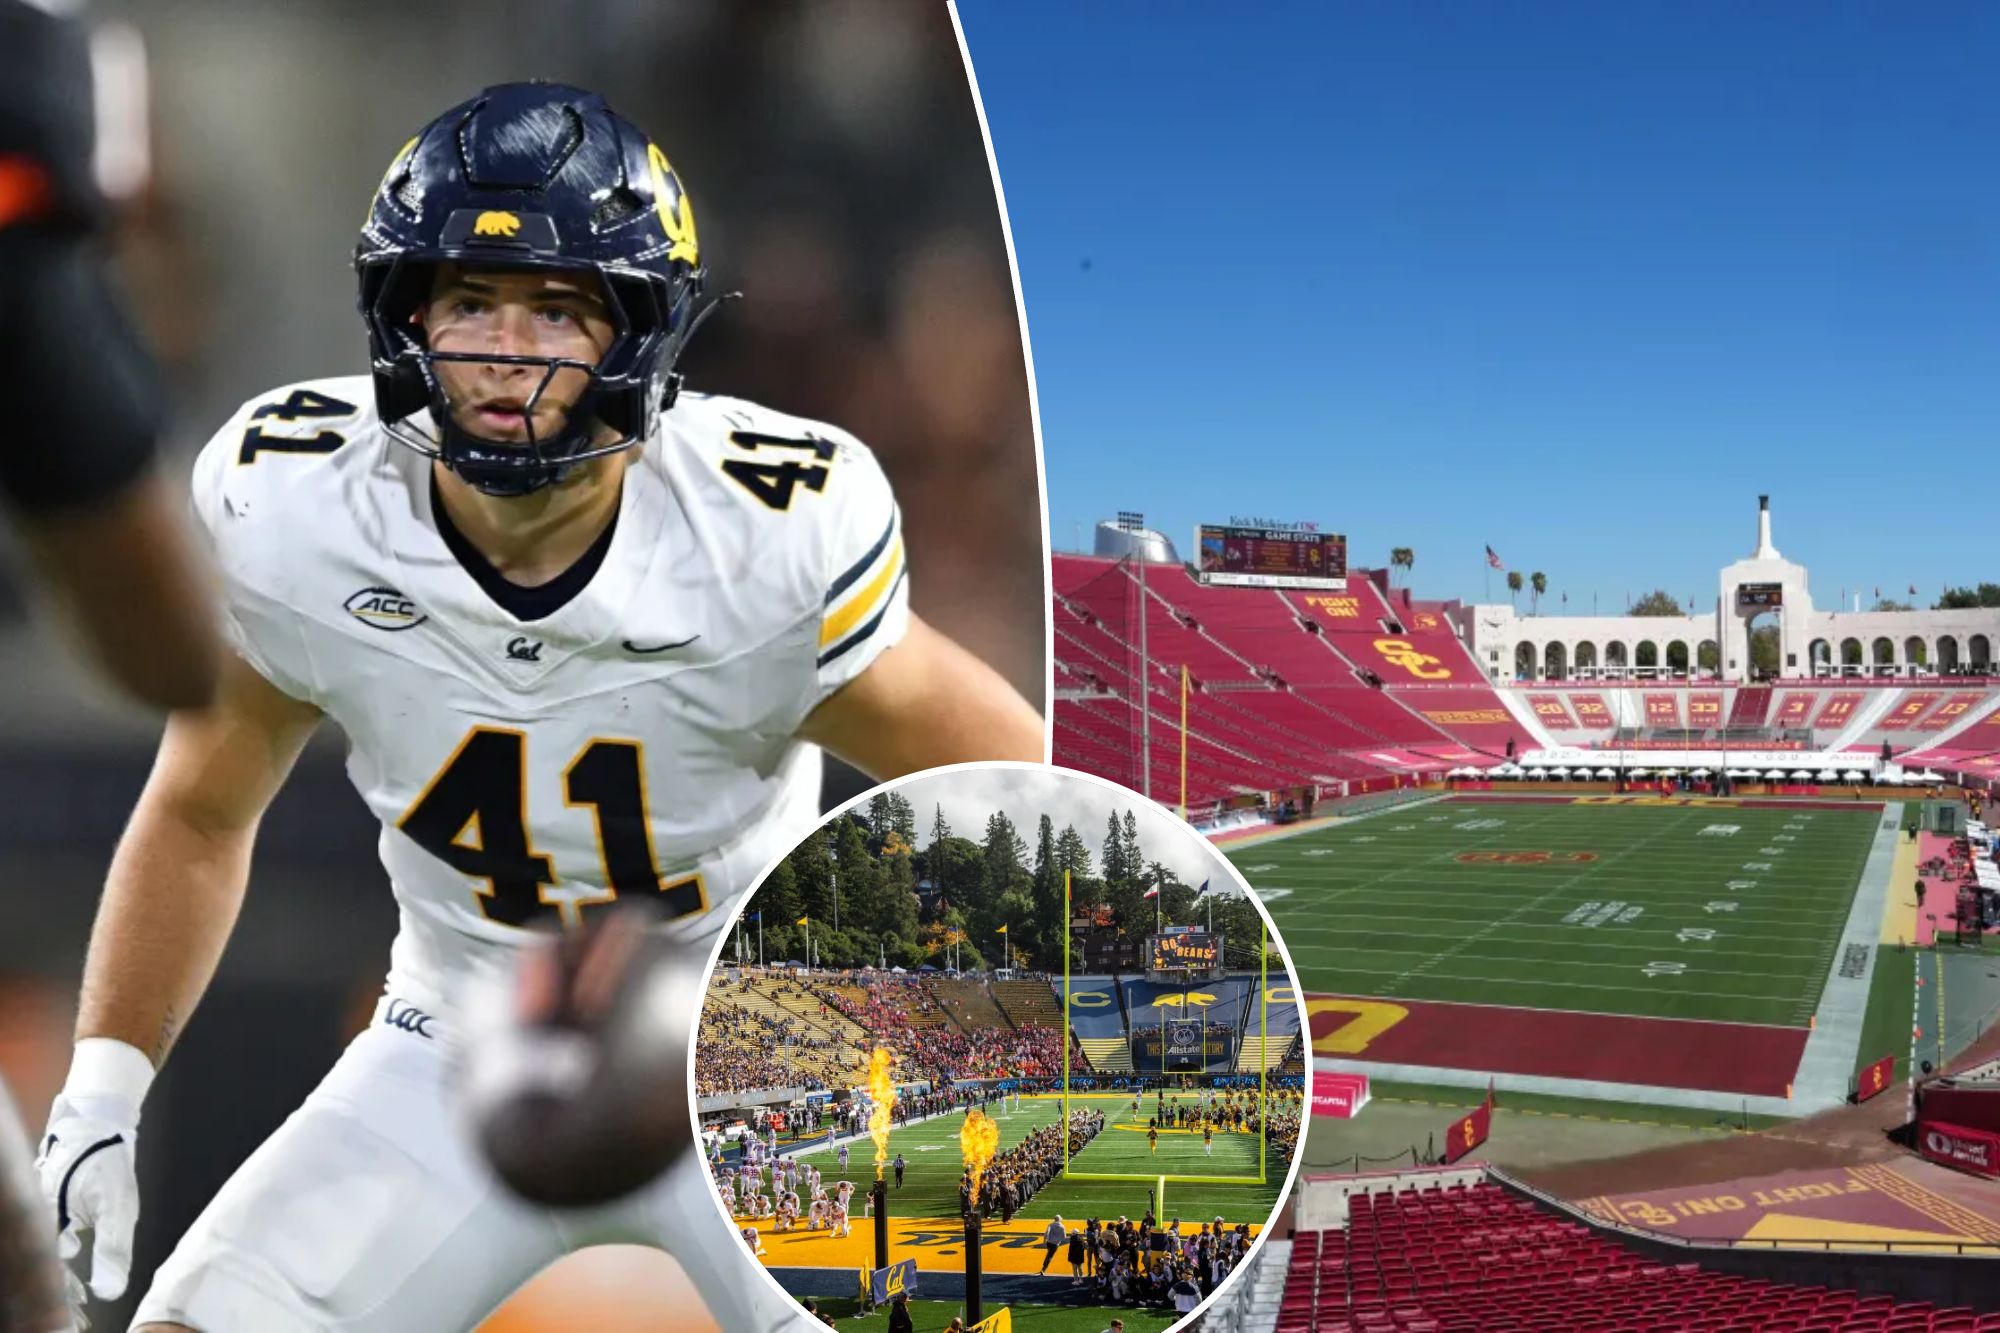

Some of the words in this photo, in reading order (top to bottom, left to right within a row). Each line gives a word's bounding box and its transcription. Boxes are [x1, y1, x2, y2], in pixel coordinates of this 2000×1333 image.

[237, 389, 358, 465] 41
[720, 430, 837, 511] 41
[1265, 531, 1291, 540] GAME
[358, 597, 417, 616] ACC
[507, 636, 543, 661] Cal
[1535, 703, 1565, 714] 20
[1576, 703, 1603, 714] 32
[1650, 703, 1673, 713] 12
[1691, 703, 1718, 713] 33
[395, 724, 710, 928] 41
[1161, 938, 1177, 951] GO
[1070, 992, 1111, 1007] C
[1168, 1045, 1200, 1054] Allstate
[1752, 1180, 1868, 1206] FIGHT
[1674, 1195, 1745, 1217] ON!
[886, 1265, 906, 1298] Cal
